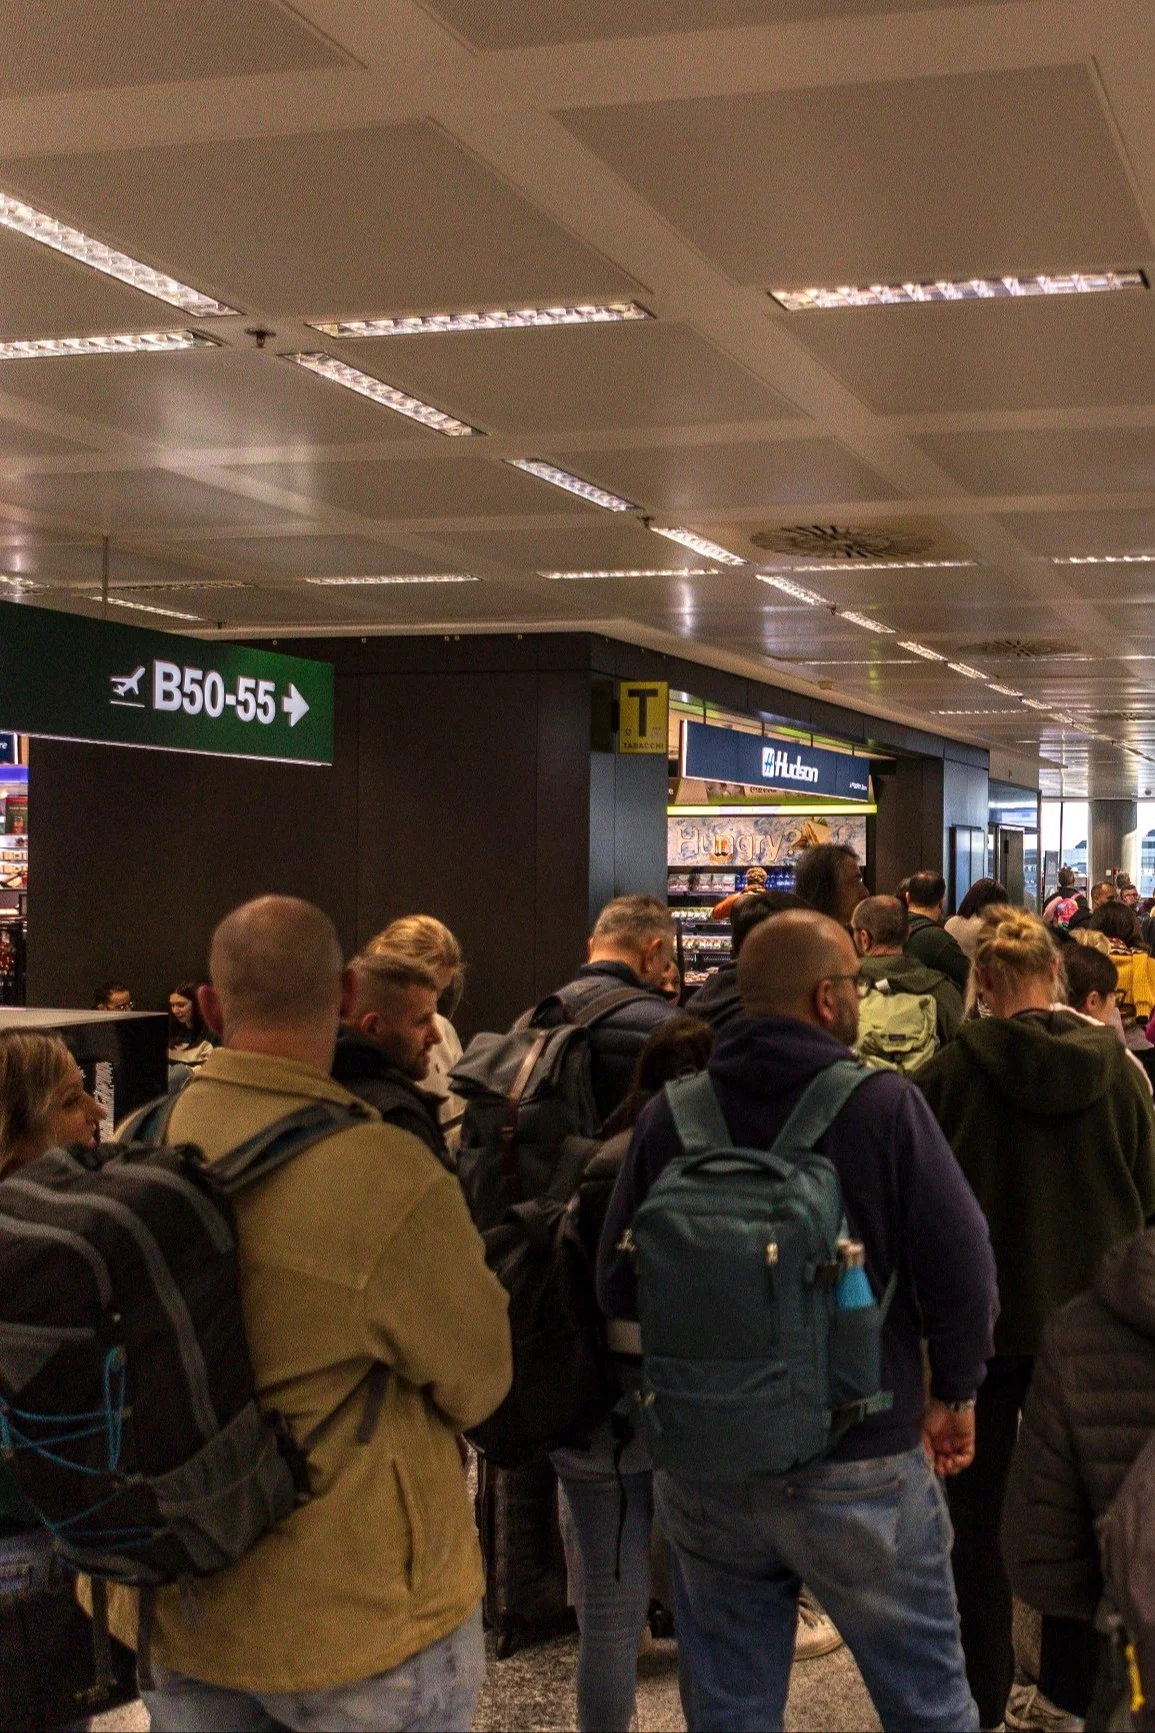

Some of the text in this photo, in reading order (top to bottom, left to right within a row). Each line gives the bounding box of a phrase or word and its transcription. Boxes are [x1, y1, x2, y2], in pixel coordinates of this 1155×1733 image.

[153, 659, 276, 725] B50-55
[628, 689, 659, 737] T
[624, 742, 664, 750] TABACCHI
[775, 750, 819, 783] Hudson
[677, 826, 802, 863] Hungry?
